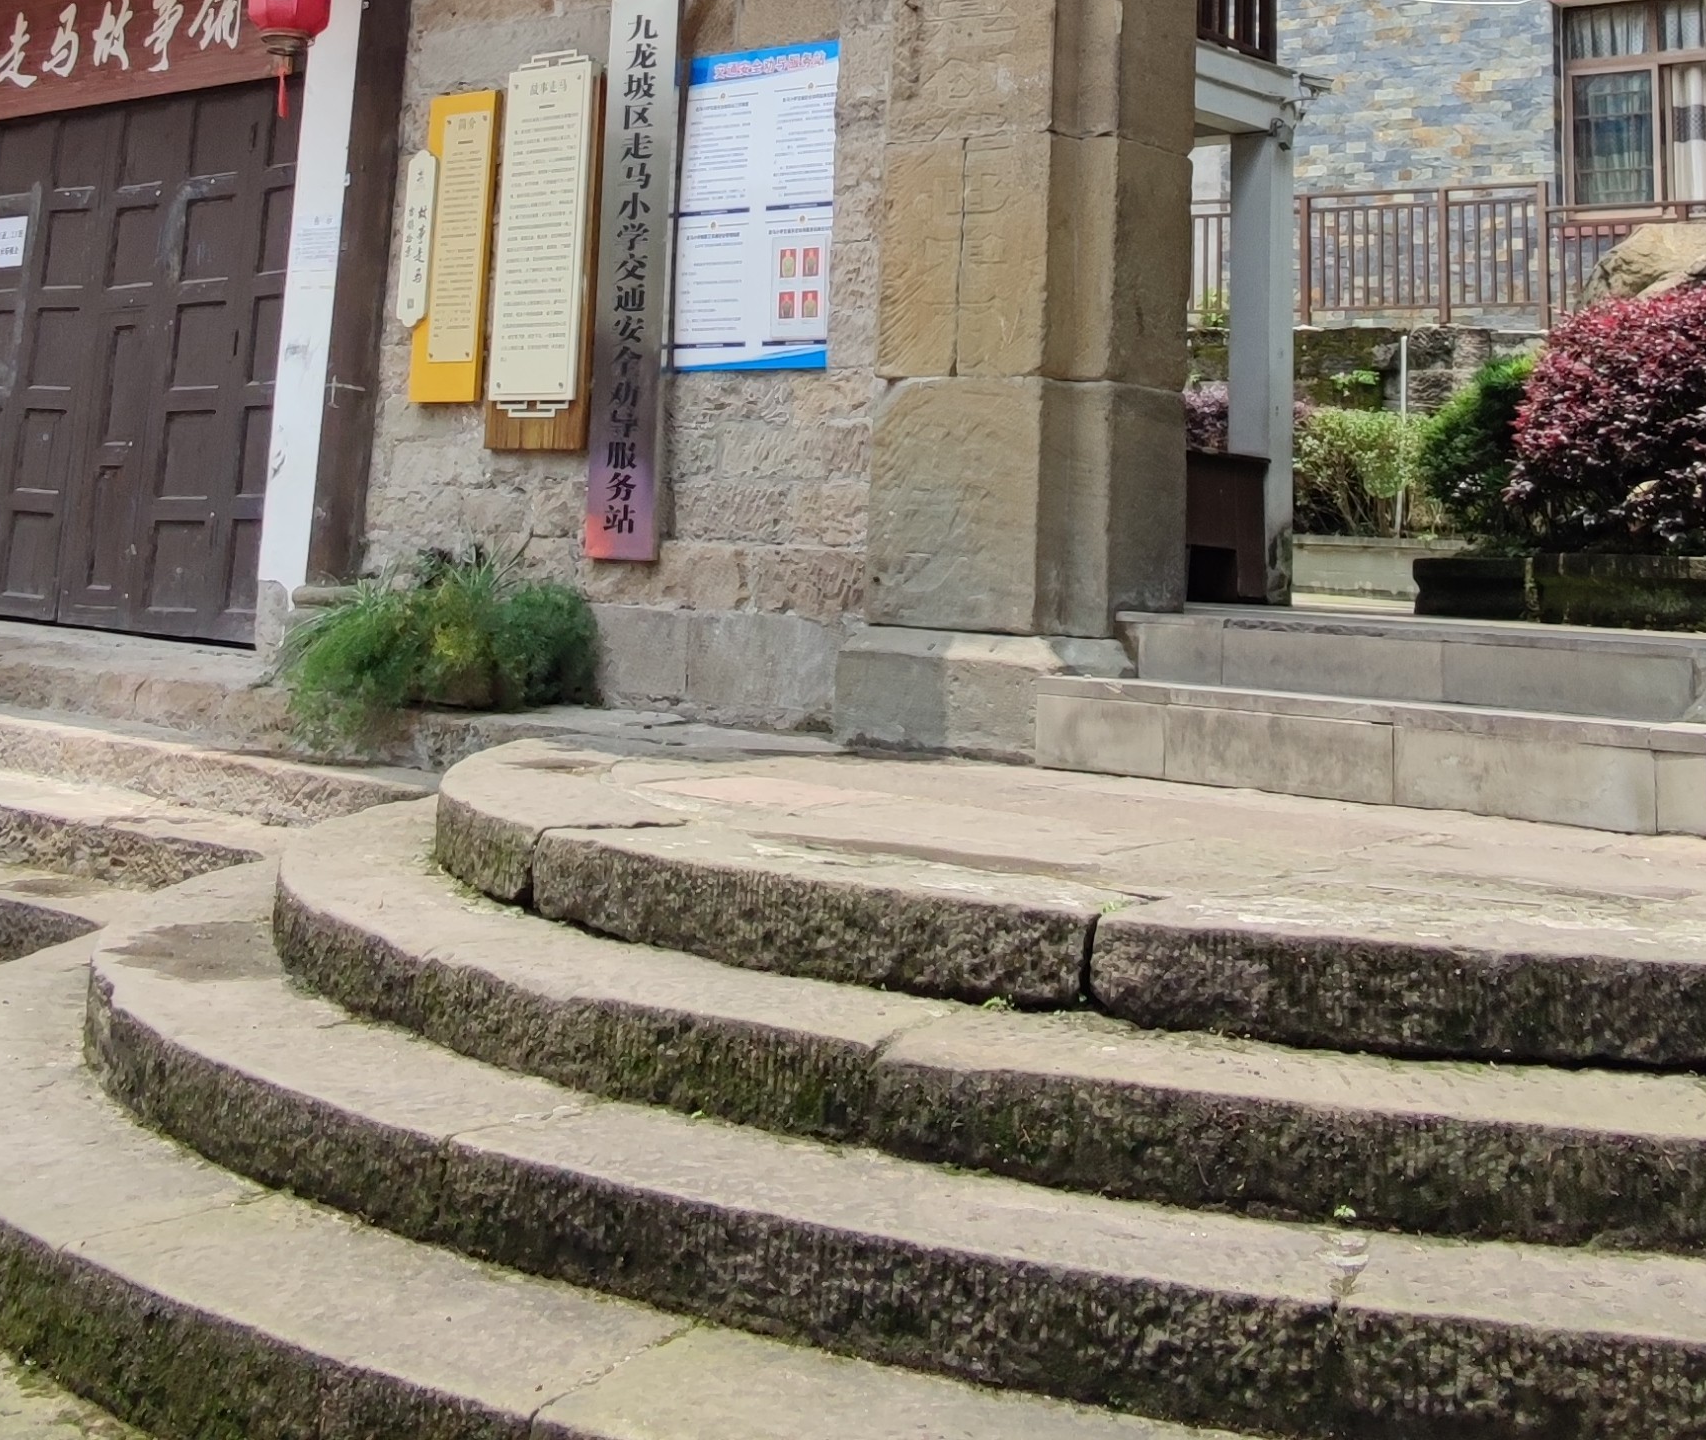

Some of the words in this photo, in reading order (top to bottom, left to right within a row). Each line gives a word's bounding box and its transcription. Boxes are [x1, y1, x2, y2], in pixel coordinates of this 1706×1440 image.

[602, 14, 660, 534] 九龙坡区走马小学交通安全劝导服务站
